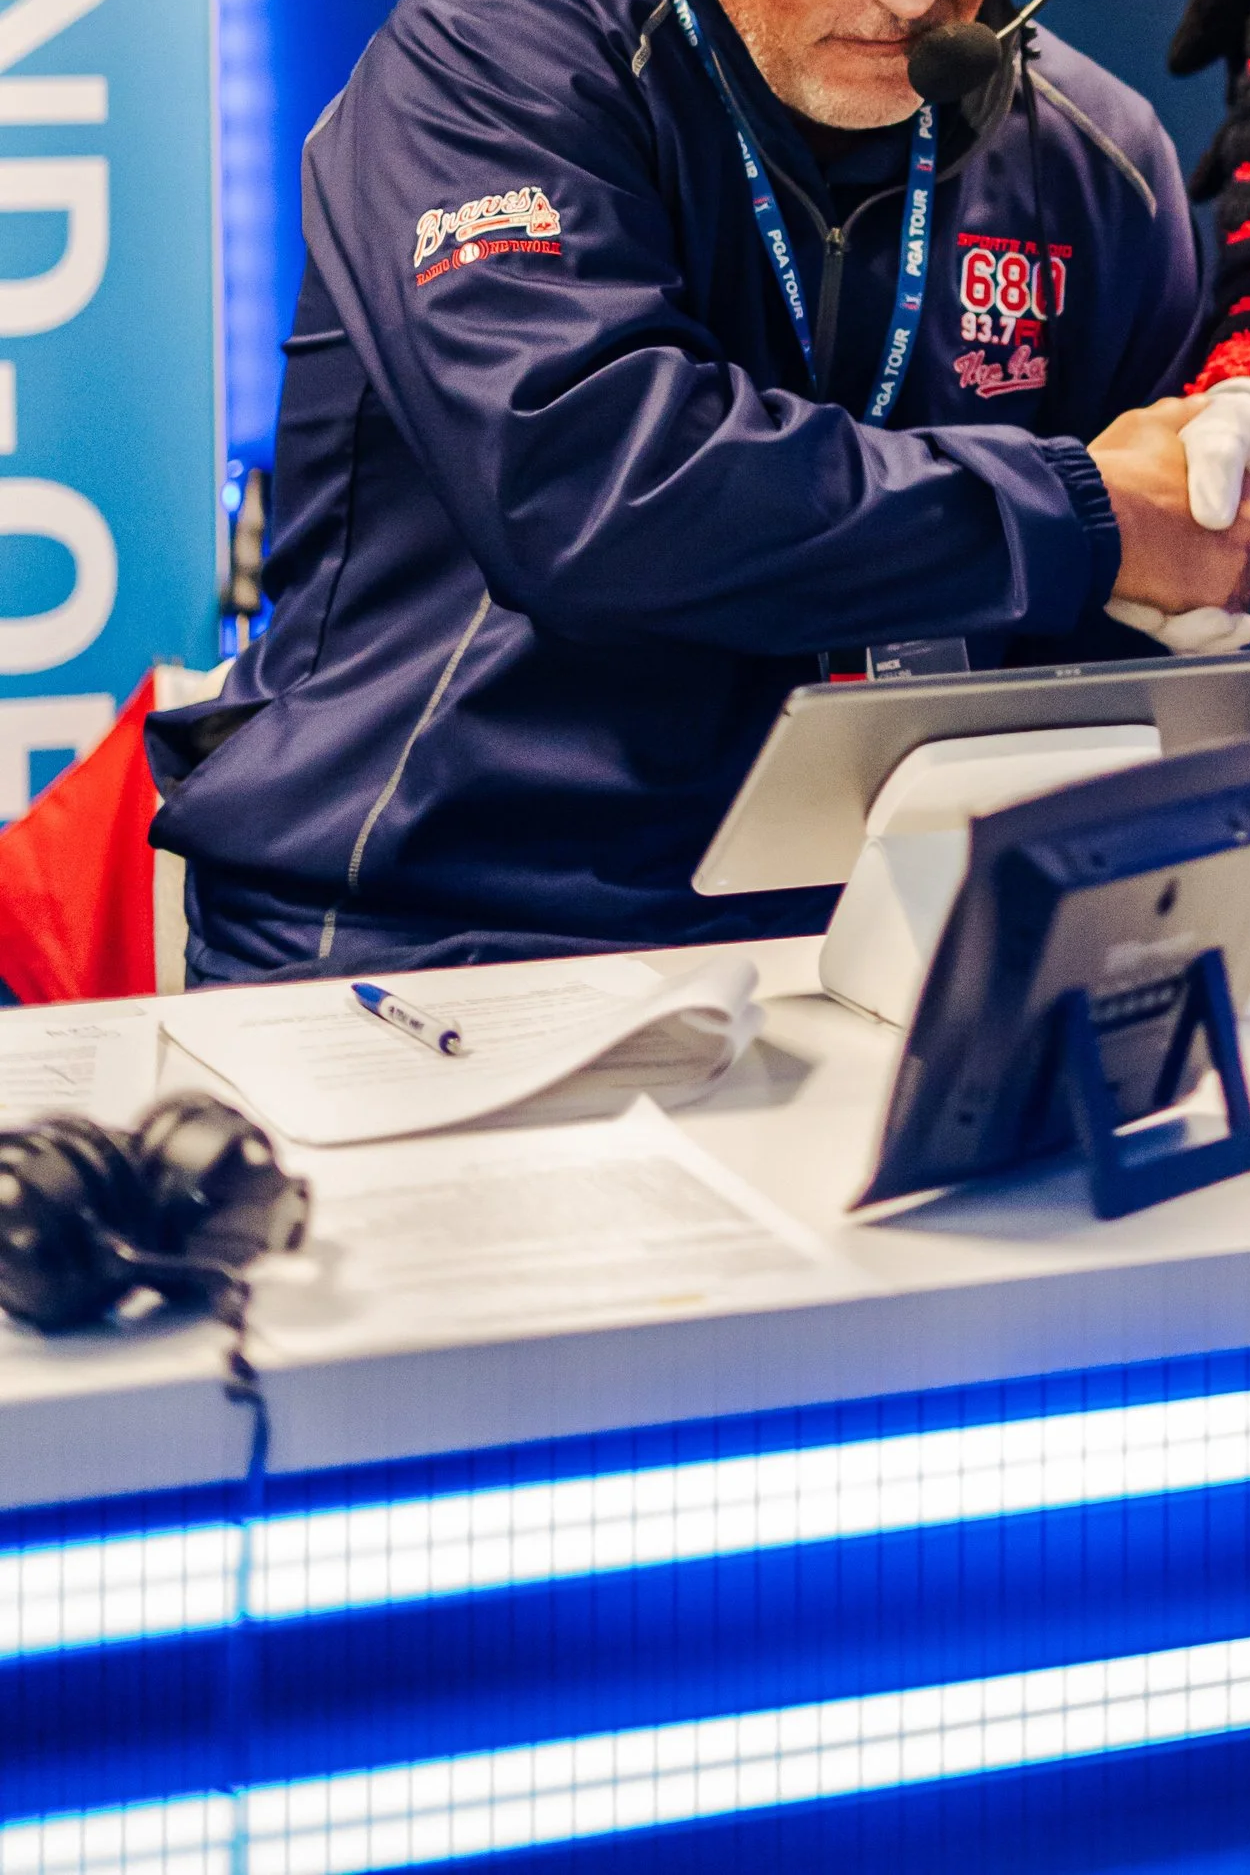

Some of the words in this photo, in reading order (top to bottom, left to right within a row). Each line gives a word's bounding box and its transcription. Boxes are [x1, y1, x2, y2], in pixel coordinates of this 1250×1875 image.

[414, 186, 531, 268] Braves
[909, 189, 928, 237] TOUR
[416, 258, 451, 287] RADIO
[489, 239, 562, 257] NETWORK
[906, 240, 925, 276] PGA
[957, 232, 1021, 253] SPORTS
[1025, 240, 1073, 258] RDIO
[767, 229, 790, 268] PGA
[783, 269, 804, 320] TOUR
[960, 248, 1067, 320] 680
[872, 381, 895, 417] PGA
[885, 328, 911, 376] TOUR
[1008, 344, 1049, 380] Fa
